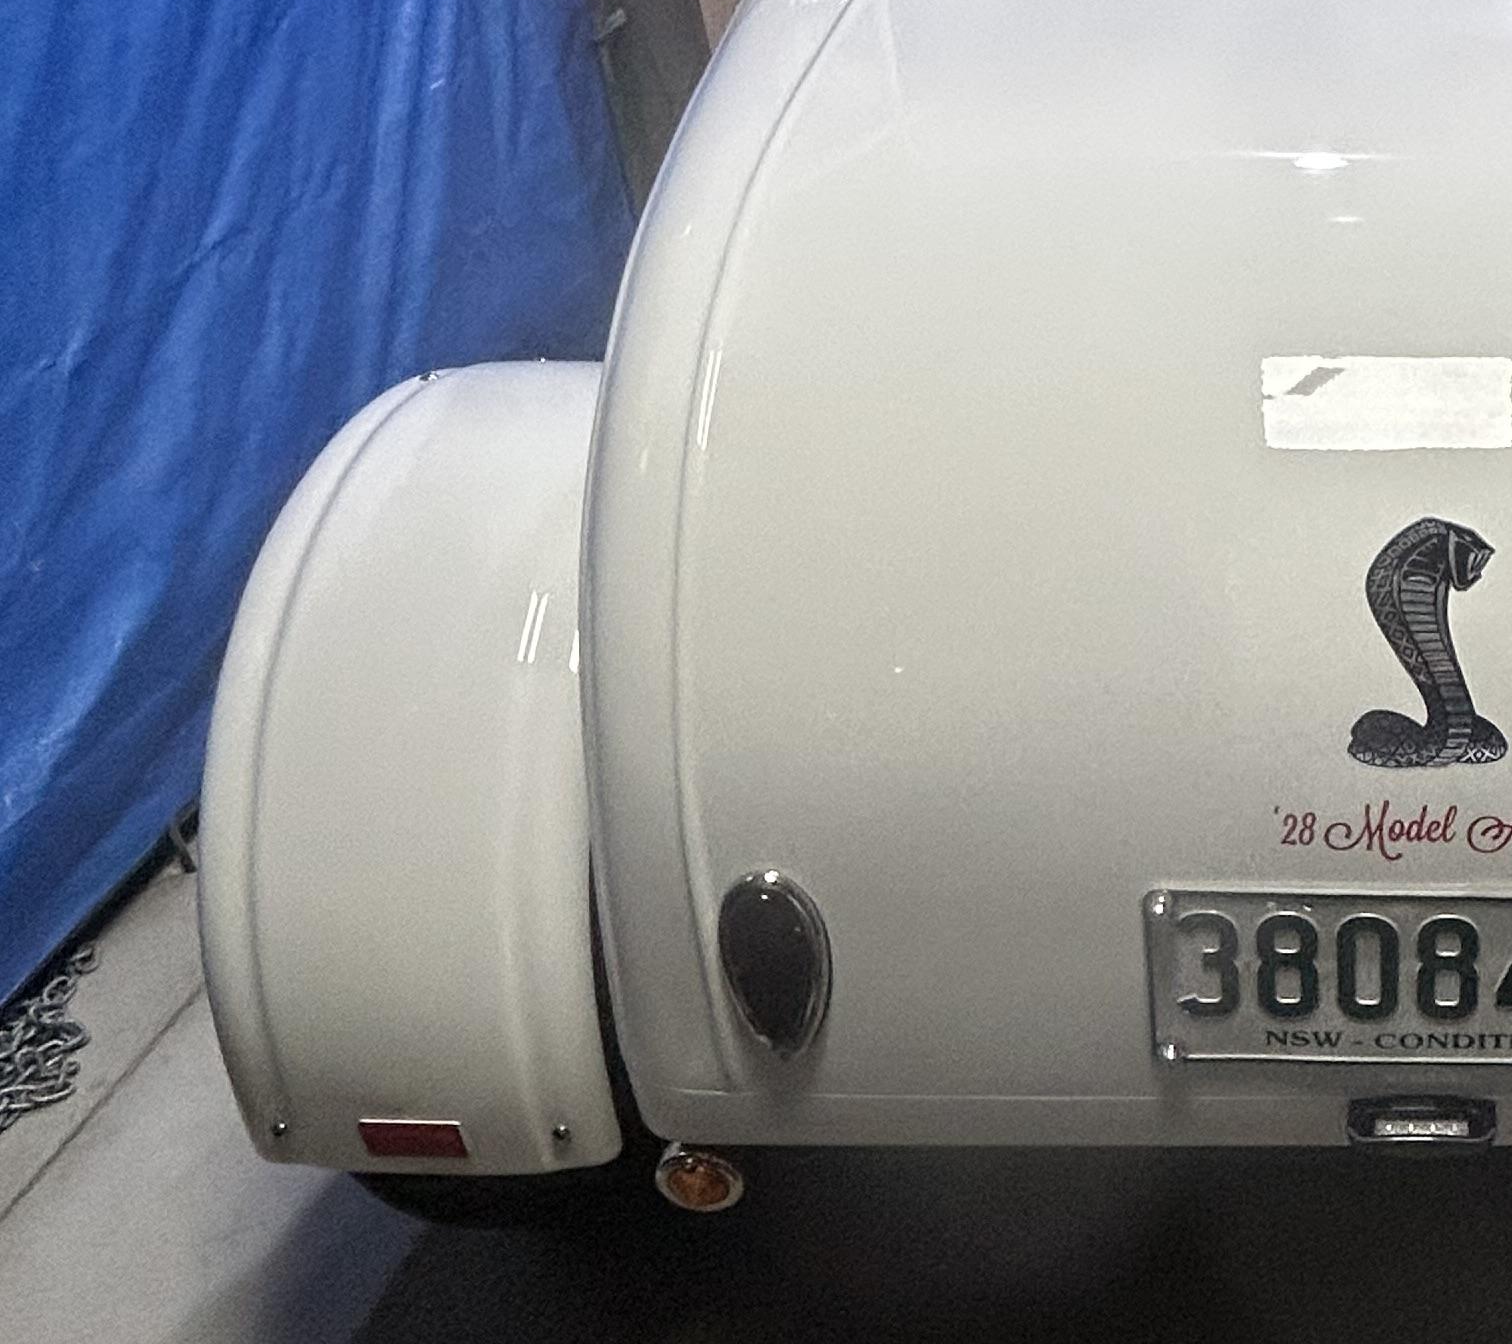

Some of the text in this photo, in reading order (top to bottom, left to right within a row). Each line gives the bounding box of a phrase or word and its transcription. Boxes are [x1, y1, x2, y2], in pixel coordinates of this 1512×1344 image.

[1275, 805, 1316, 846] '28
[1324, 800, 1457, 860] Model
[1264, 1030, 1342, 1050] NSW
